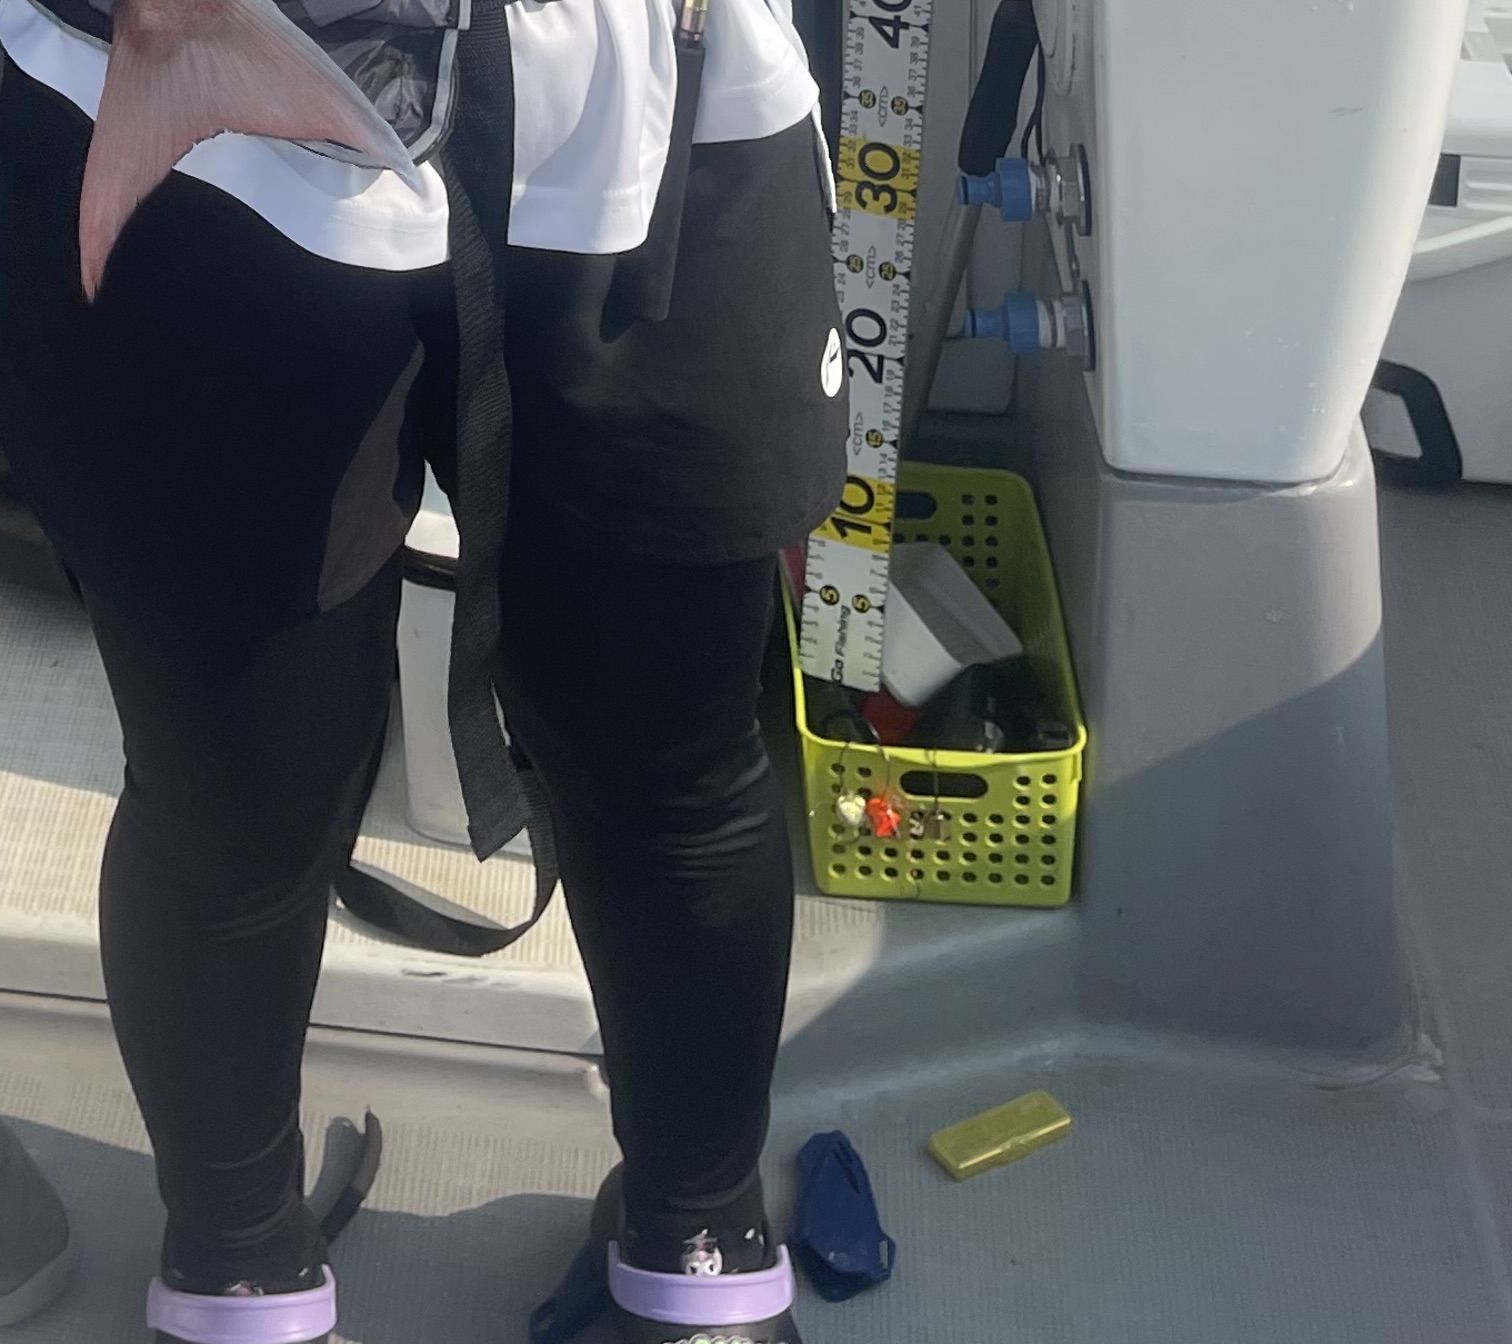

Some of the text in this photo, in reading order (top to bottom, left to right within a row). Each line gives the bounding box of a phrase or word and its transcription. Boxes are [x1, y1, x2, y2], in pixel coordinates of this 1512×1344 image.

[860, 91, 875, 108] 35
[892, 97, 907, 115] 35
[855, 142, 900, 214] 30
[846, 308, 887, 384] 20
[867, 430, 882, 447] 15
[830, 475, 874, 539] 10
[821, 587, 837, 604] 5
[853, 597, 869, 612] 5
[831, 604, 851, 683] Go Fishing
